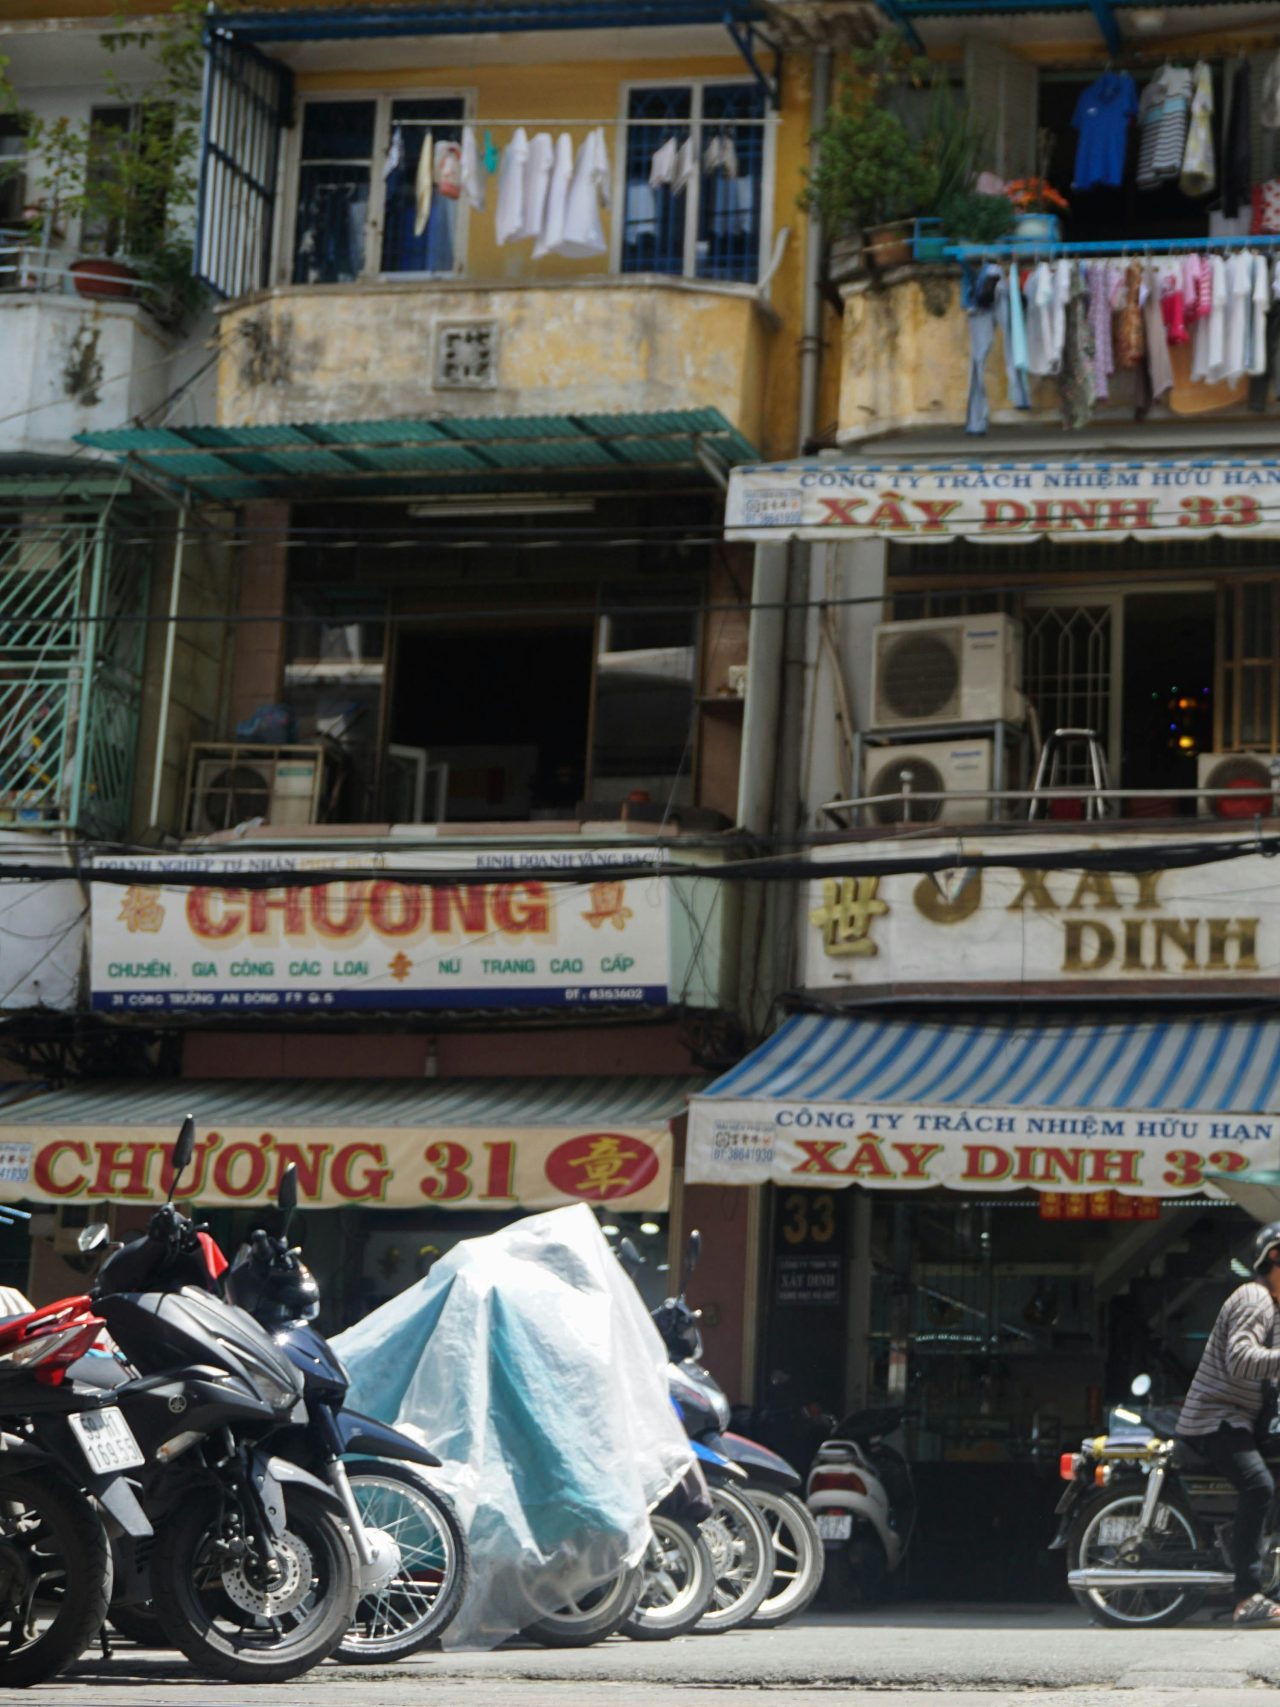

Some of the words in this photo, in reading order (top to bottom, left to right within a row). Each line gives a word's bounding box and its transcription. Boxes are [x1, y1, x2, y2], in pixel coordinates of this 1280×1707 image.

[888, 472, 919, 488] TY
[1043, 469, 1139, 490] NHIỆM
[816, 491, 961, 531] XÂY
[979, 497, 1158, 531] DINH
[1177, 494, 1262, 529] 33
[481, 959, 536, 974] TRANG
[550, 958, 584, 974] CAO
[1060, 917, 1260, 971] DINH
[775, 1107, 855, 1129] CÔNG
[866, 1112, 903, 1130] TY
[914, 1111, 1015, 1133] TRÁCH
[1025, 1114, 1125, 1139] NHIỆM
[1137, 1117, 1199, 1139] HỮU
[1209, 1122, 1273, 1144] HẠN
[33, 1131, 394, 1200] CHƯƠNG
[418, 1140, 518, 1201] 31
[568, 1135, 638, 1197] 章
[791, 1131, 945, 1180] XÂY
[960, 1143, 1145, 1186] DINH
[783, 1194, 835, 1244] 33
